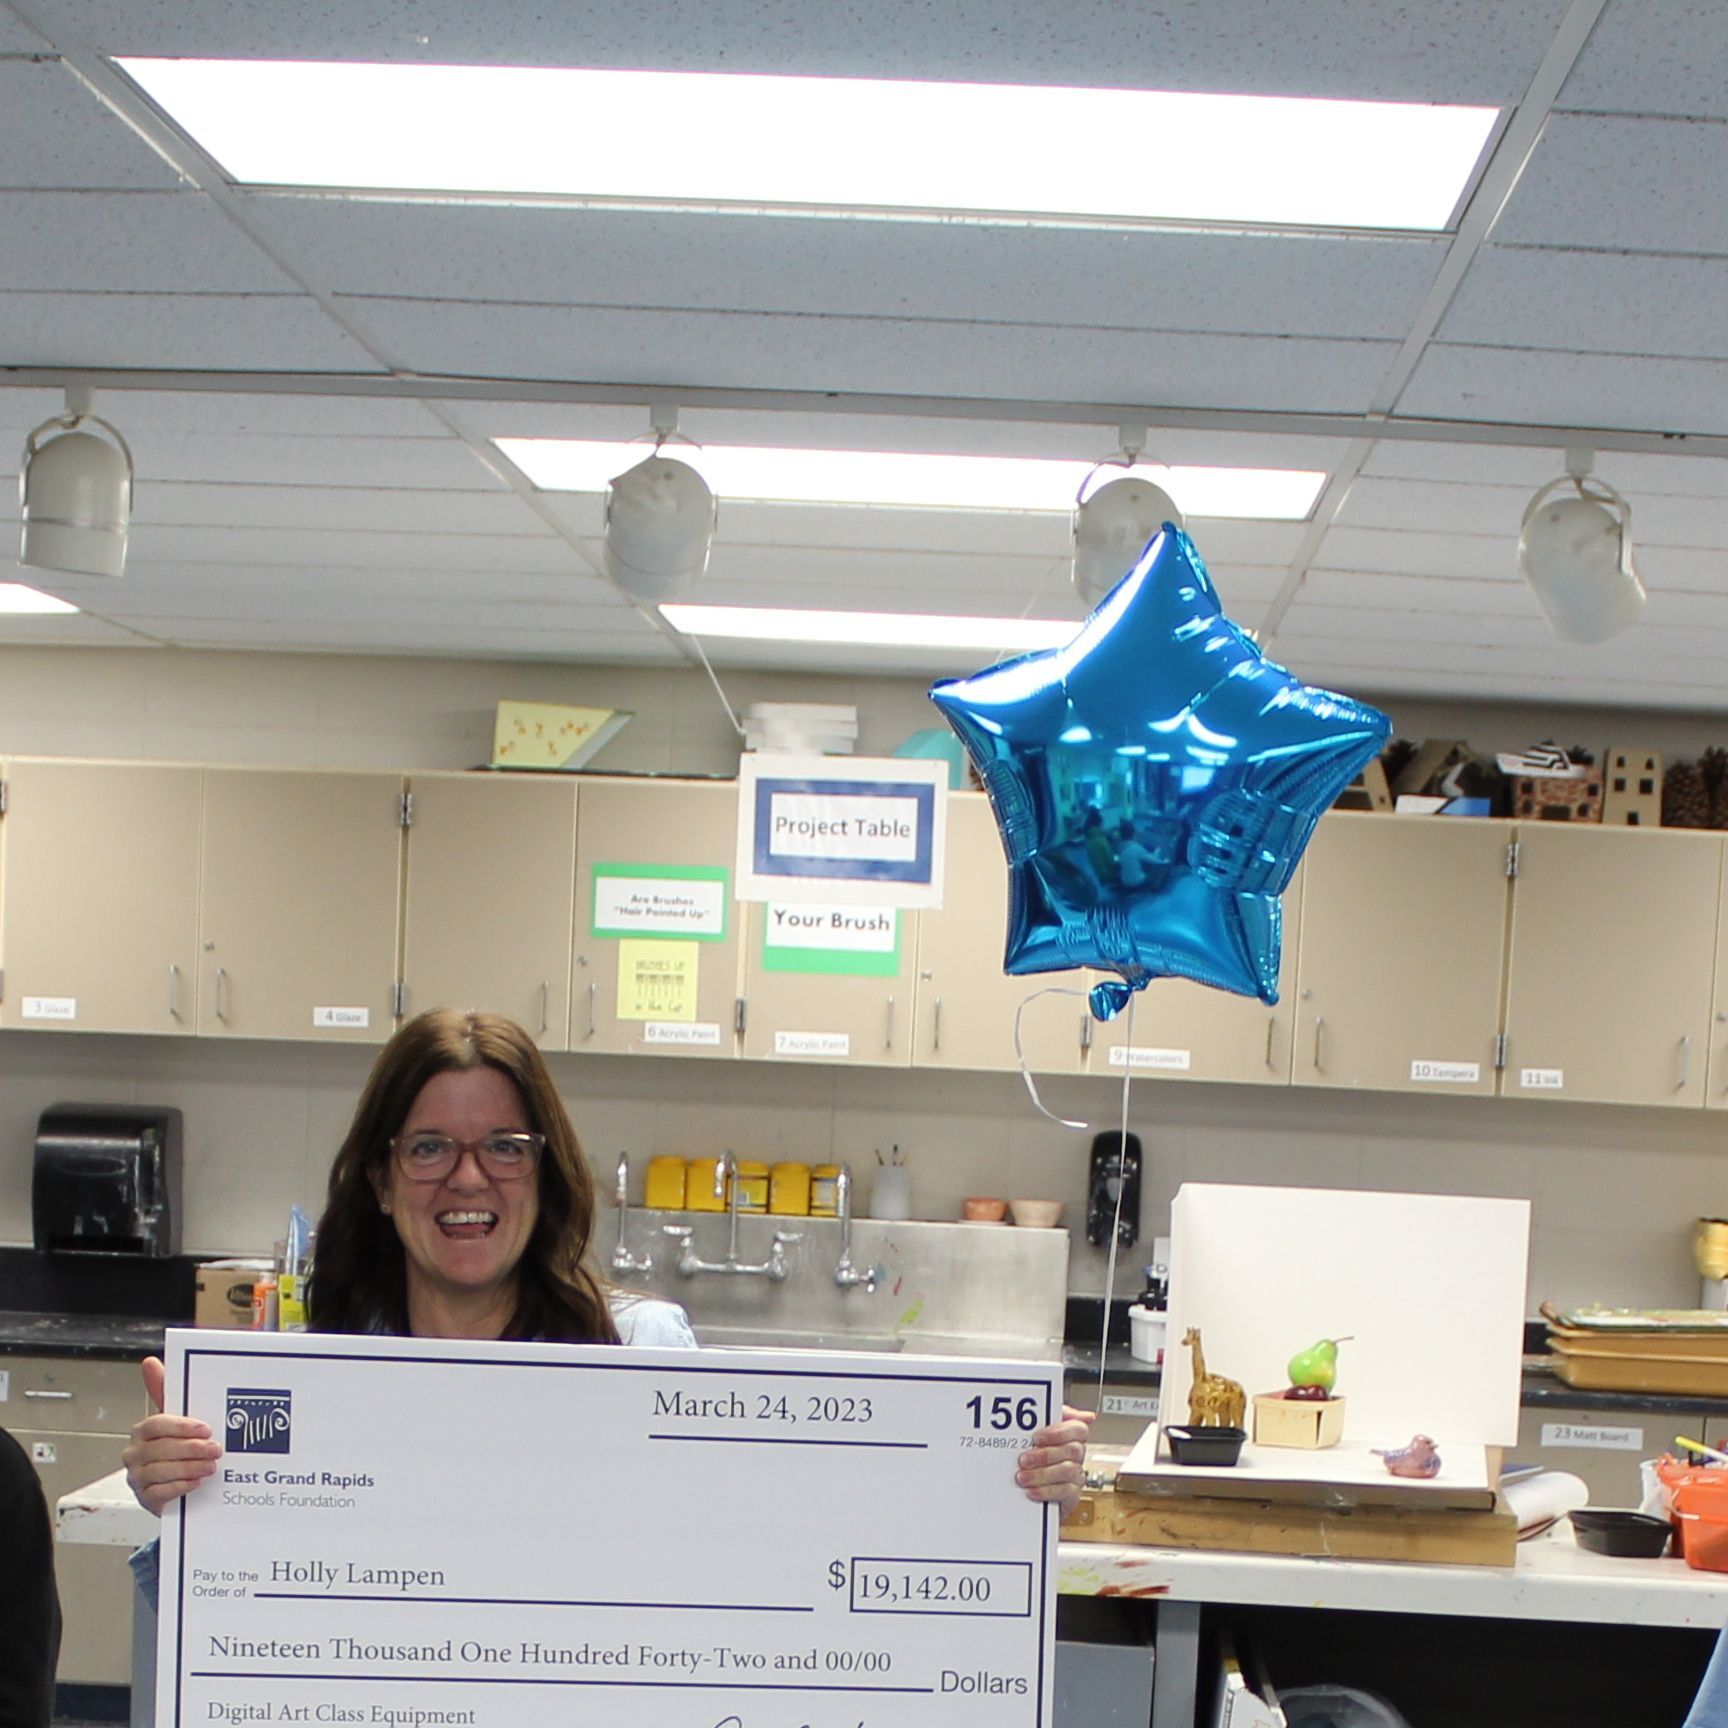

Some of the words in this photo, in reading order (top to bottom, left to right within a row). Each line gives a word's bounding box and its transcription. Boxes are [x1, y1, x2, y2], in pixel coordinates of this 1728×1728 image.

[776, 816, 849, 838] Project
[854, 818, 911, 838] Table
[652, 895, 694, 907] Brushes
[774, 908, 824, 928] Your
[831, 912, 890, 931] Brush
[1414, 1064, 1431, 1077] 10
[653, 1390, 746, 1420] March
[756, 1394, 797, 1424] 24,
[806, 1396, 874, 1423] 2023
[965, 1395, 1039, 1431] 156
[1106, 1398, 1122, 1411] 21
[1554, 1426, 1571, 1440] 23
[223, 1469, 260, 1485] East
[265, 1470, 316, 1487] Grand
[321, 1472, 375, 1491] Rapids
[222, 1490, 275, 1507] Schools
[279, 1492, 356, 1509] Foundation
[193, 1569, 217, 1585] Pay
[222, 1571, 235, 1583] to
[238, 1570, 259, 1583] the
[270, 1560, 339, 1591] Holly
[346, 1562, 446, 1592] Lampen
[828, 1559, 847, 1590] $
[860, 1574, 992, 1605] 19,142.00
[192, 1585, 227, 1599] Order
[233, 1586, 247, 1598] of
[208, 1635, 321, 1661] Nineteen
[329, 1637, 453, 1663] Thousand
[460, 1641, 513, 1664] One
[520, 1643, 630, 1667] Hundred
[637, 1645, 768, 1675] Forty-Two
[773, 1649, 818, 1672] and
[824, 1651, 893, 1673] 00/00
[940, 1670, 1029, 1696] Dollars
[208, 1702, 272, 1726] Digital
[278, 1704, 310, 1723] Art
[315, 1704, 365, 1724] Class
